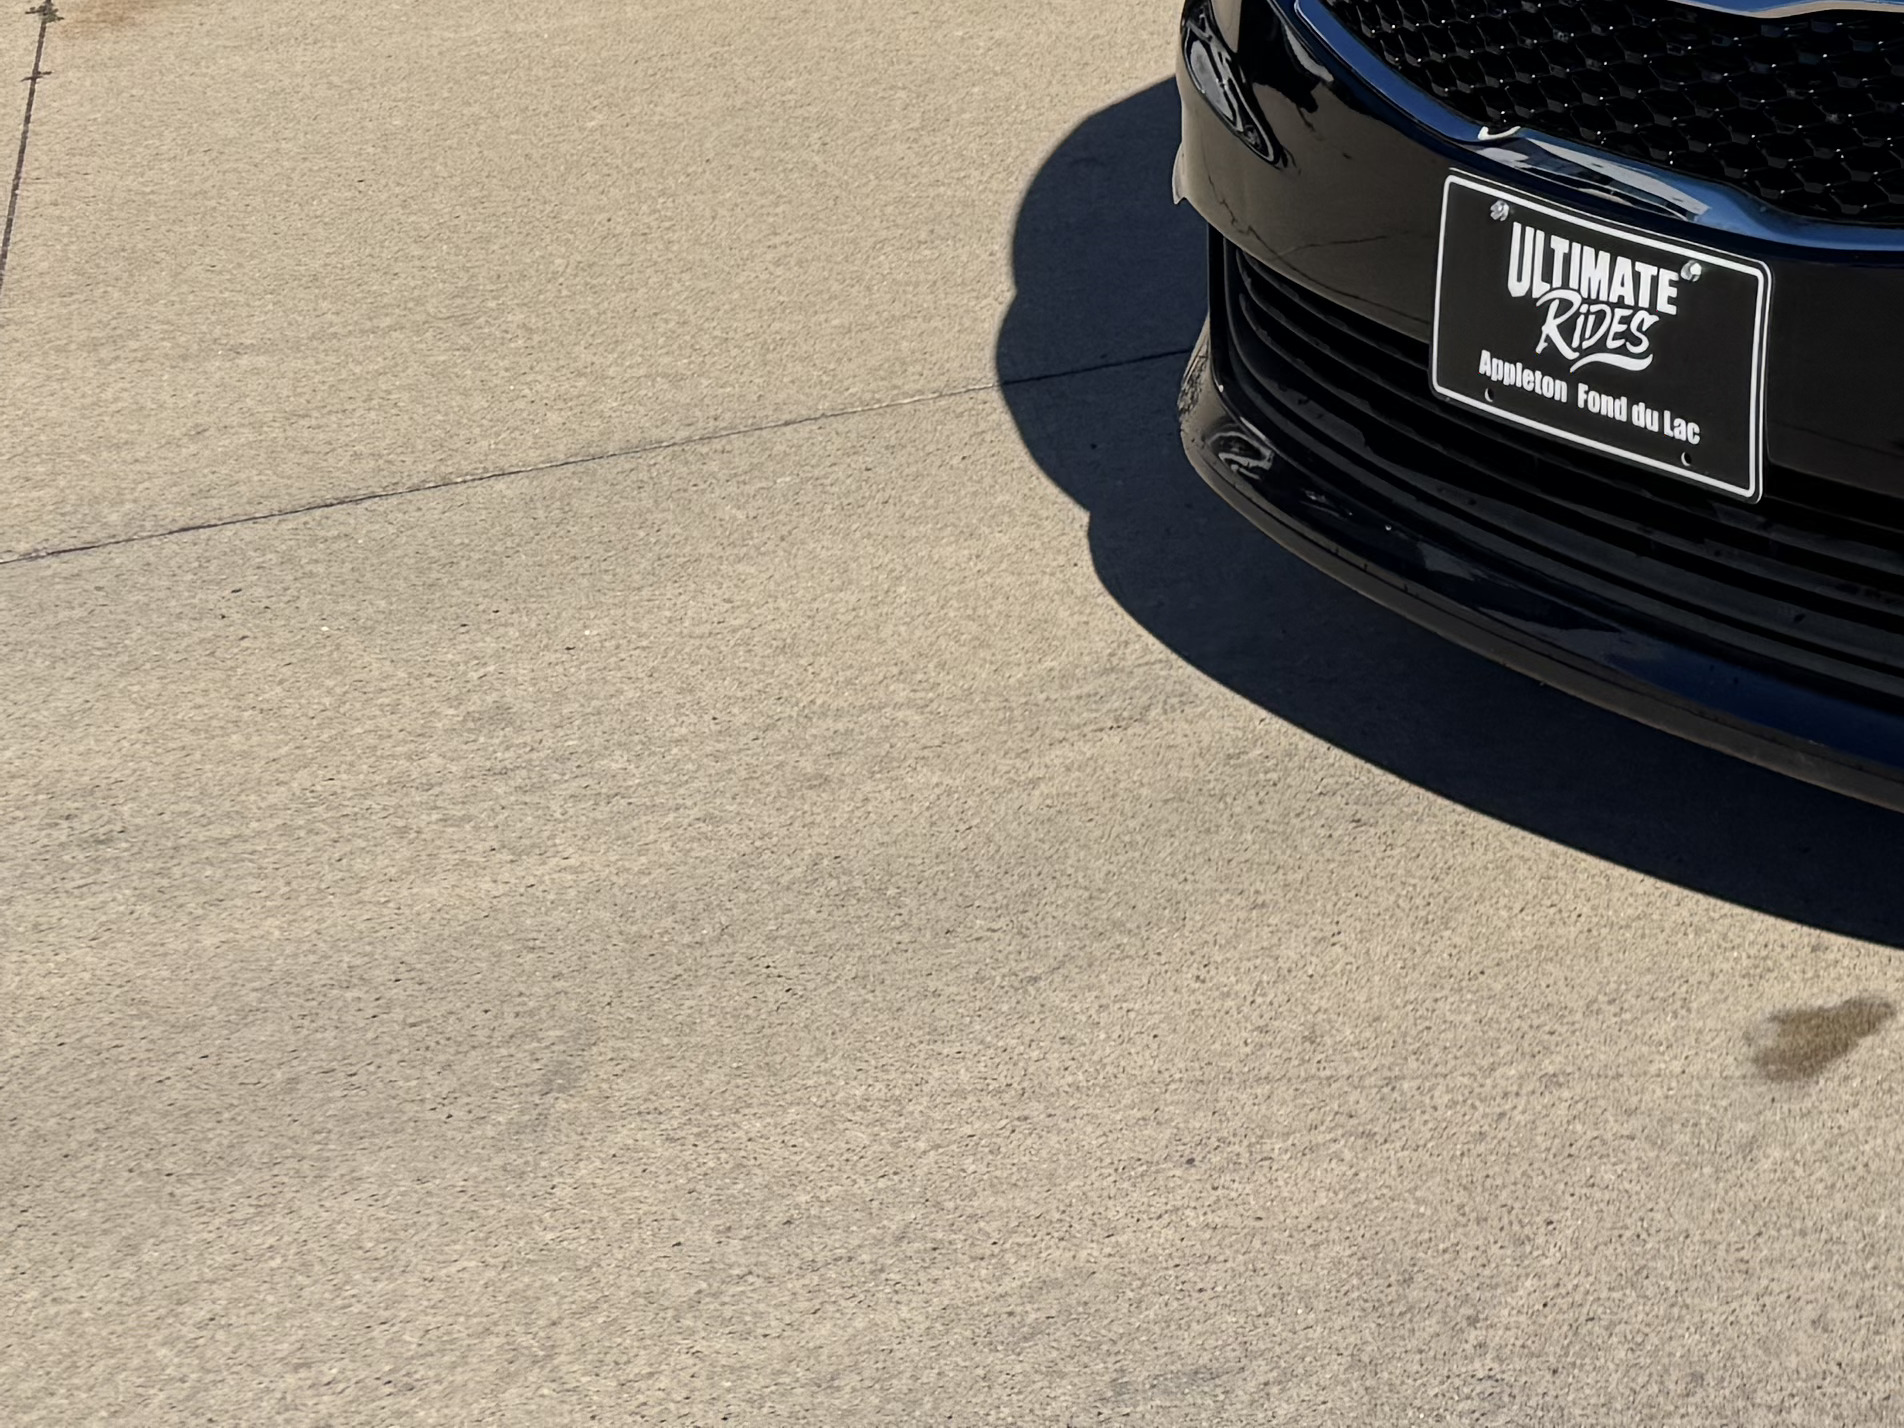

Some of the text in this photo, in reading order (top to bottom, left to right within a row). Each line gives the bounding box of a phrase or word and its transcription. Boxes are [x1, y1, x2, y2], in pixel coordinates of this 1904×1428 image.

[1507, 221, 1680, 315] ULTIMATE
[1478, 349, 1701, 445] Appleton Fond du Lac
